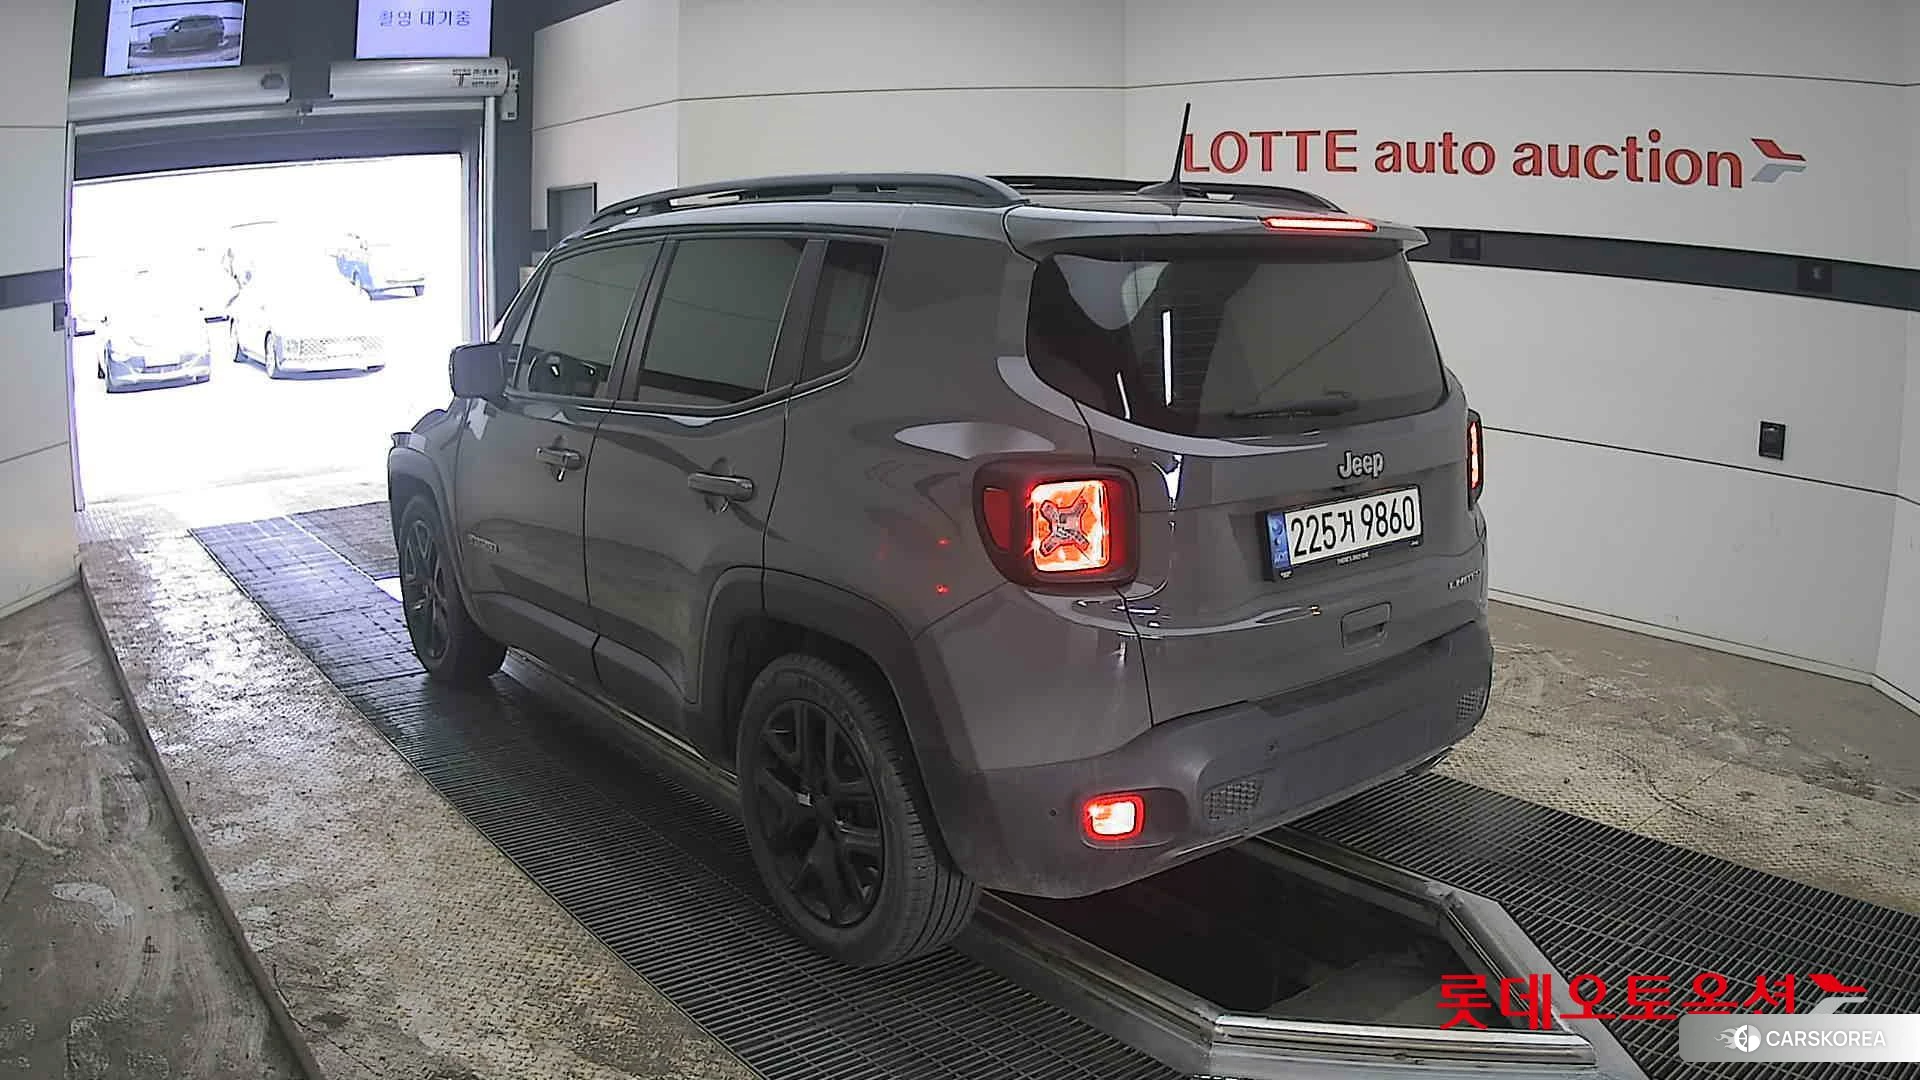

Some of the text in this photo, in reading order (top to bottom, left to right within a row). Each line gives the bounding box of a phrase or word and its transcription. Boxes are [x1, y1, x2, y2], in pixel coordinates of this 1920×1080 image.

[420, 10, 470, 27] 대기중
[1184, 129, 1744, 189] LOTTE auto auction
[1338, 450, 1385, 479] Jeep
[1291, 496, 1415, 558] 225거 9860
